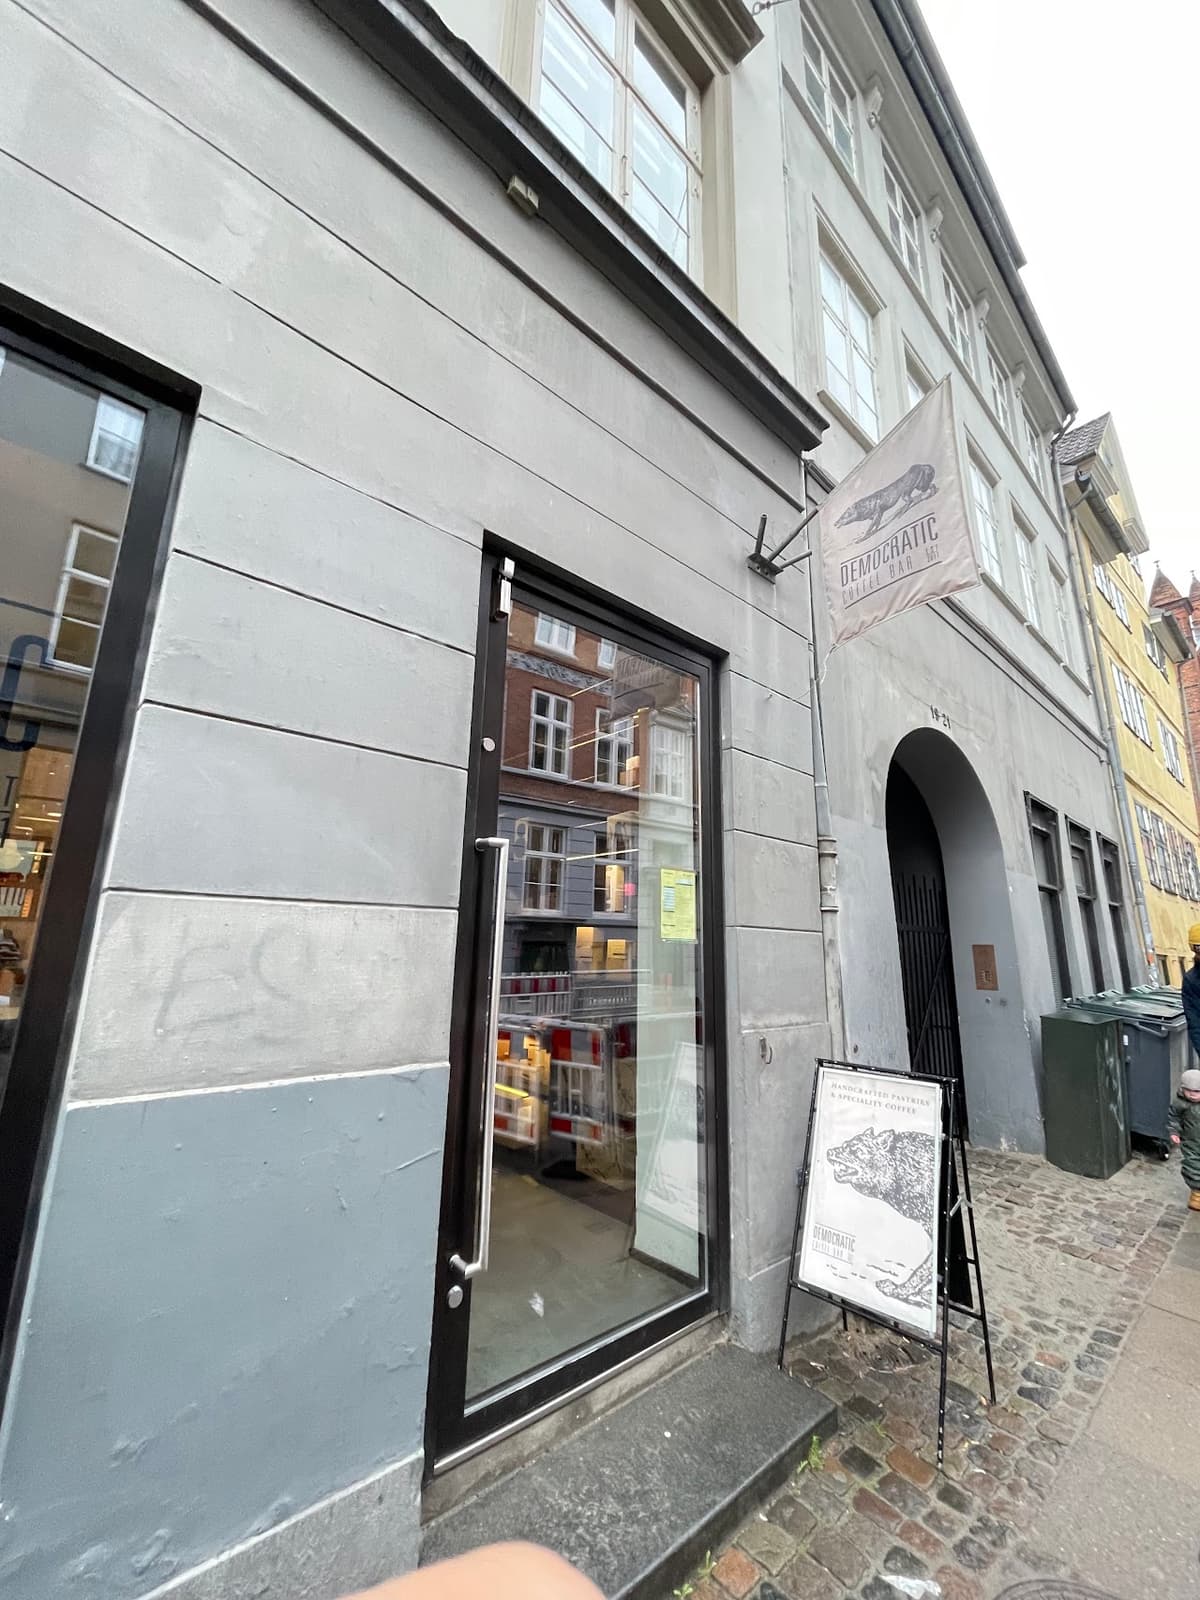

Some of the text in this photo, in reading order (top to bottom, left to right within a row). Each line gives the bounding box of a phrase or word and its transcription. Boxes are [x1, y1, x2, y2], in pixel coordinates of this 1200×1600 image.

[841, 517, 938, 588] DEMOCRATIC
[889, 555, 912, 578] BAR
[831, 1082, 930, 1107] HANDCRAFTED PASTRIES
[885, 1103, 916, 1115] COFFEE
[813, 1225, 856, 1253] DEMOCRATIC
